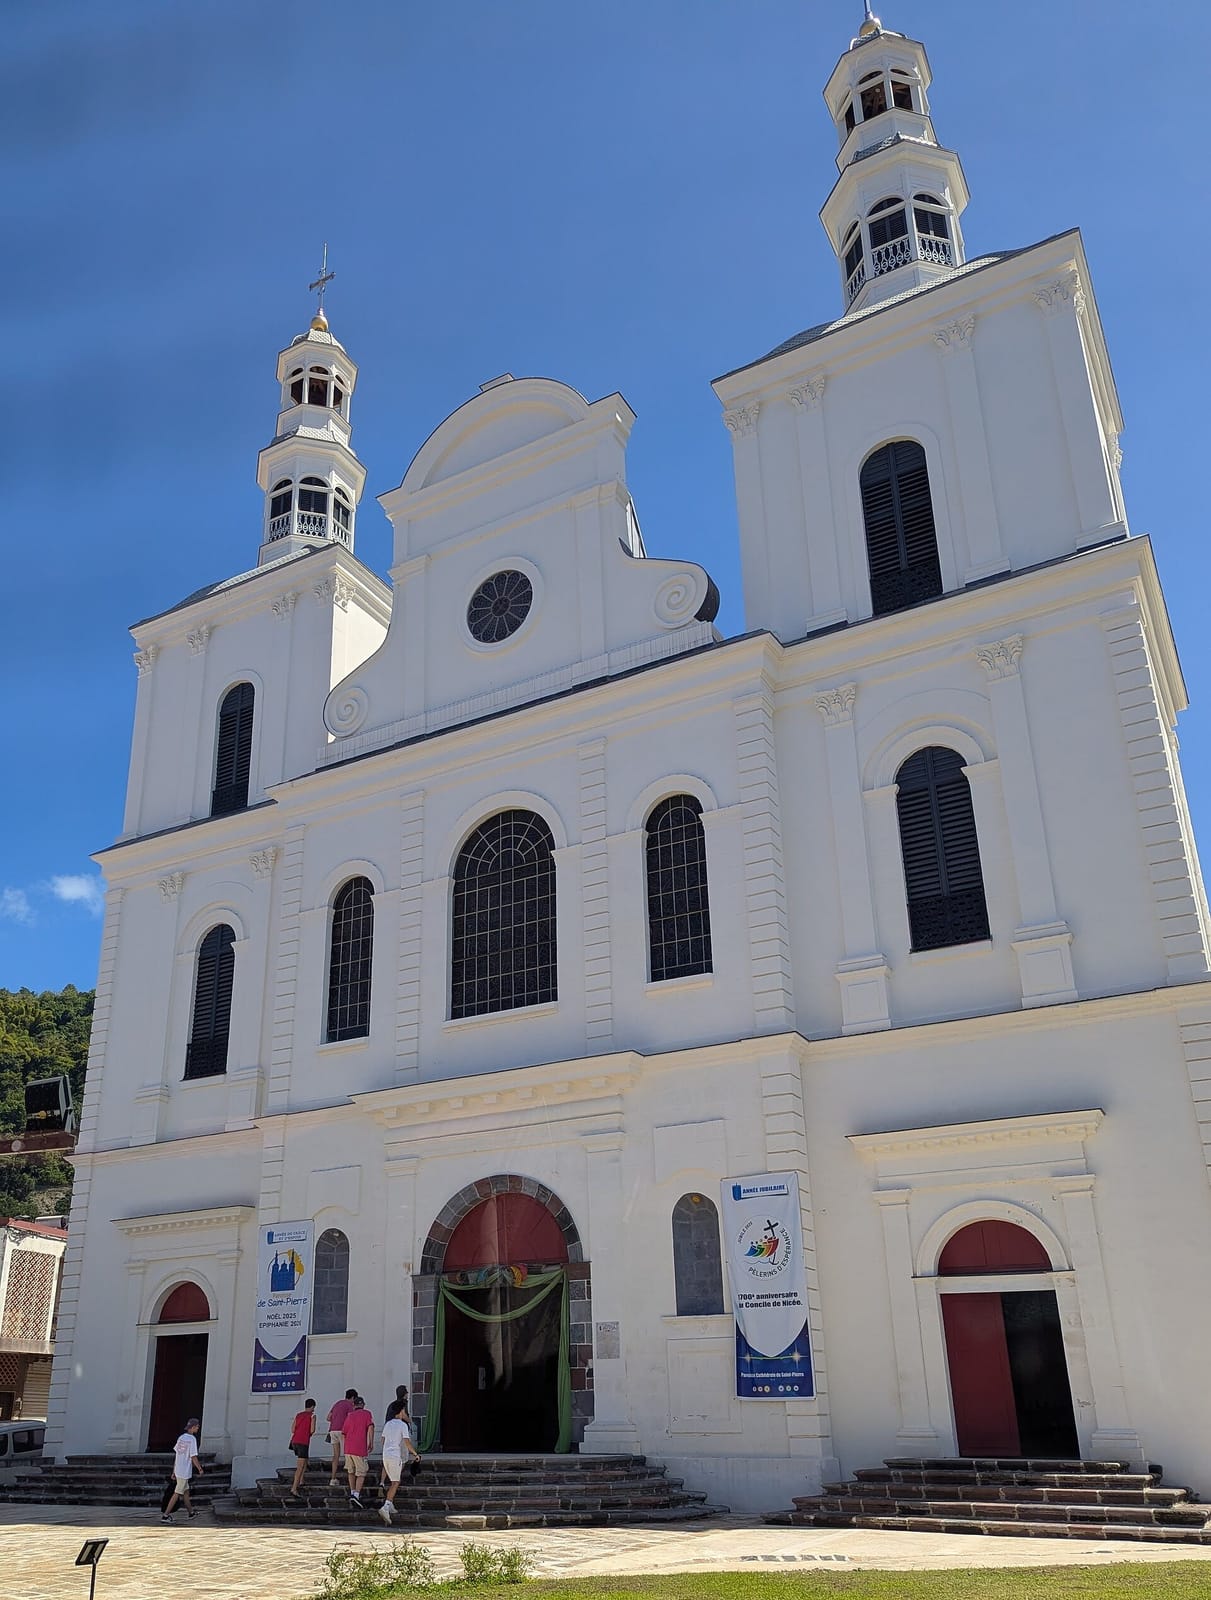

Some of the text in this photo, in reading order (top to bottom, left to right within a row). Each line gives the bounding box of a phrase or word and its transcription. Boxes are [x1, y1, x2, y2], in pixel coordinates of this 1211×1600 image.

[748, 1266, 778, 1278] PÈLERINS
[755, 1291, 799, 1300] anniversaire
[257, 1297, 308, 1308] de Saint-Pierre
[744, 1301, 771, 1309] Concile
